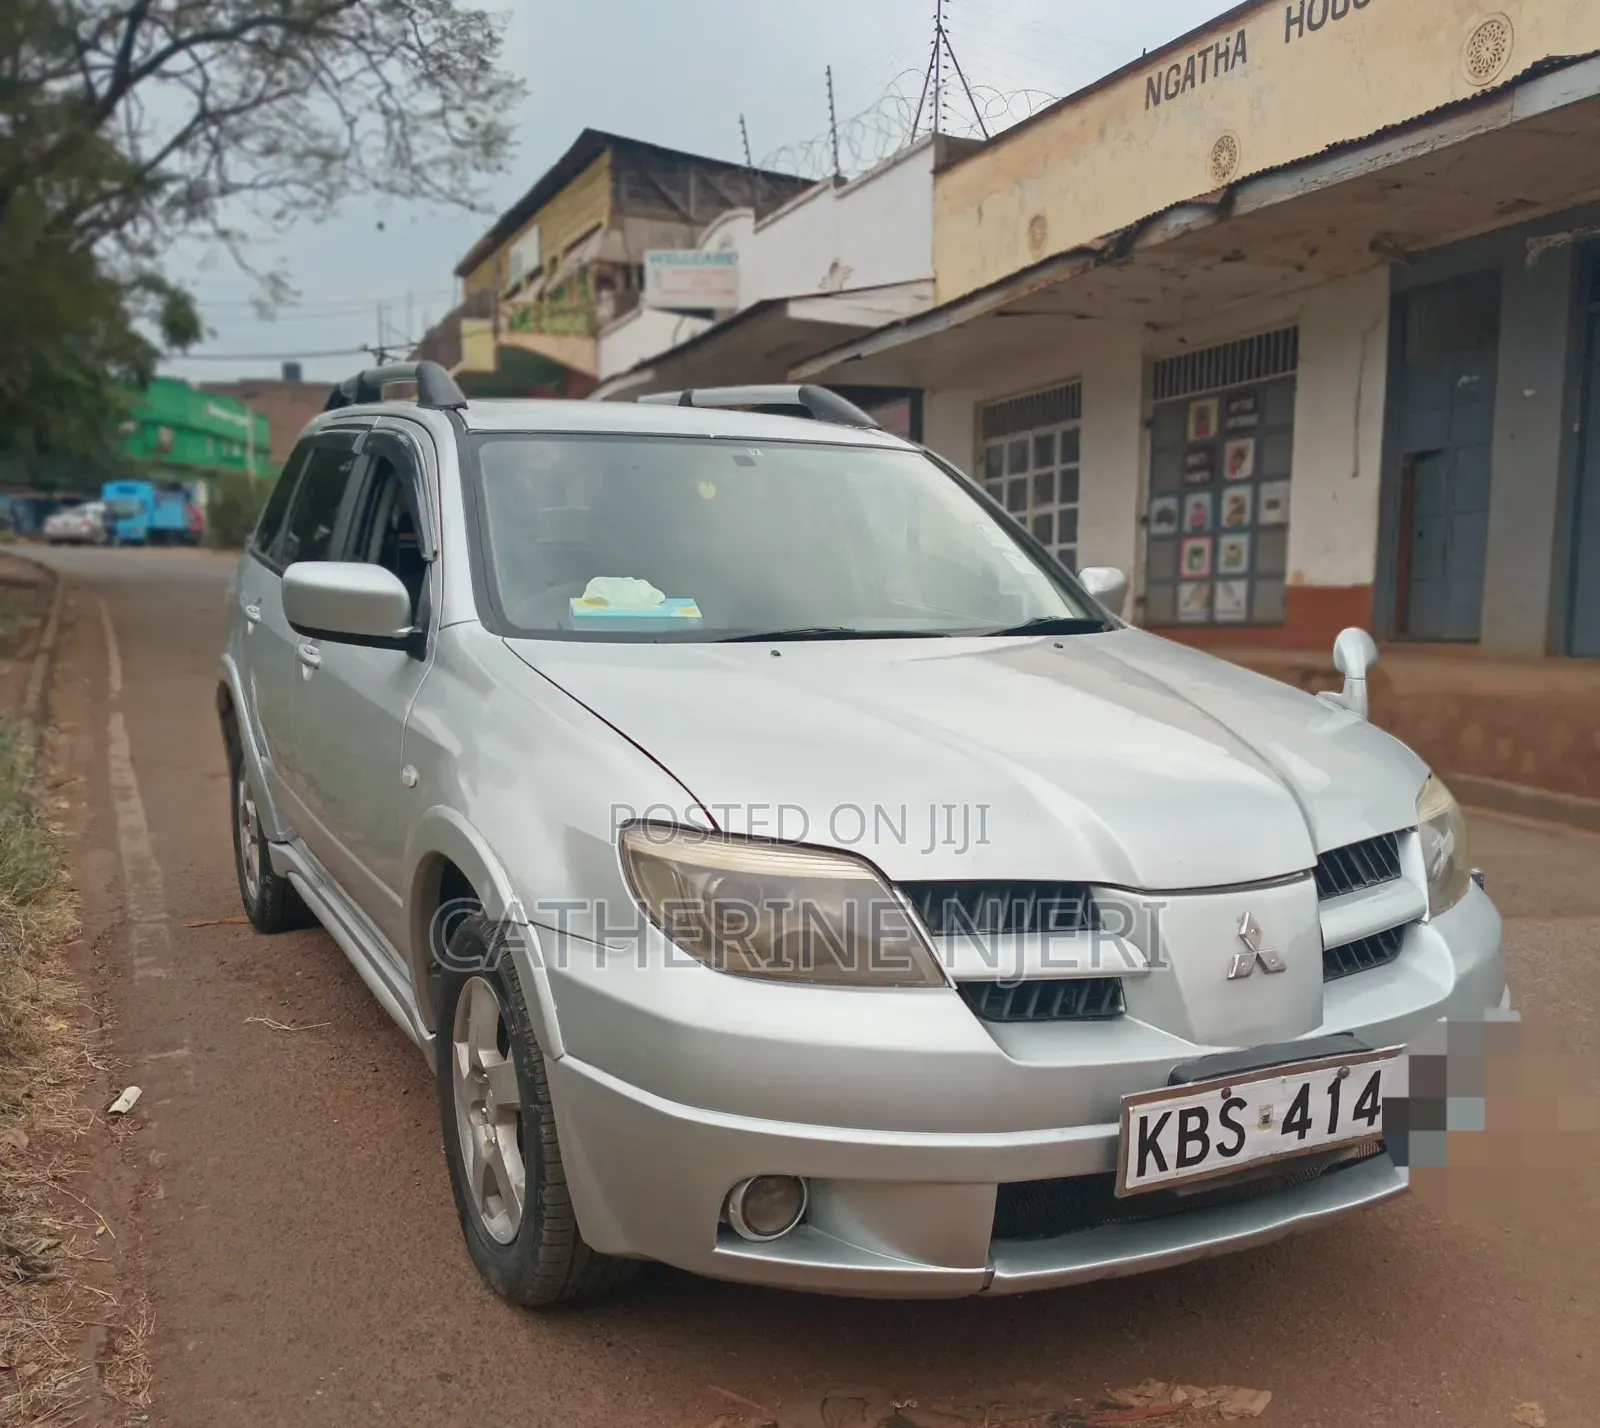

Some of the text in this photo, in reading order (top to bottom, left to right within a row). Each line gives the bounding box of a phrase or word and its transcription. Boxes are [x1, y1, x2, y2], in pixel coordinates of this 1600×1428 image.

[1145, 0, 1371, 111] NGATHA HOU
[1136, 1069, 1381, 1177] KBS 414
